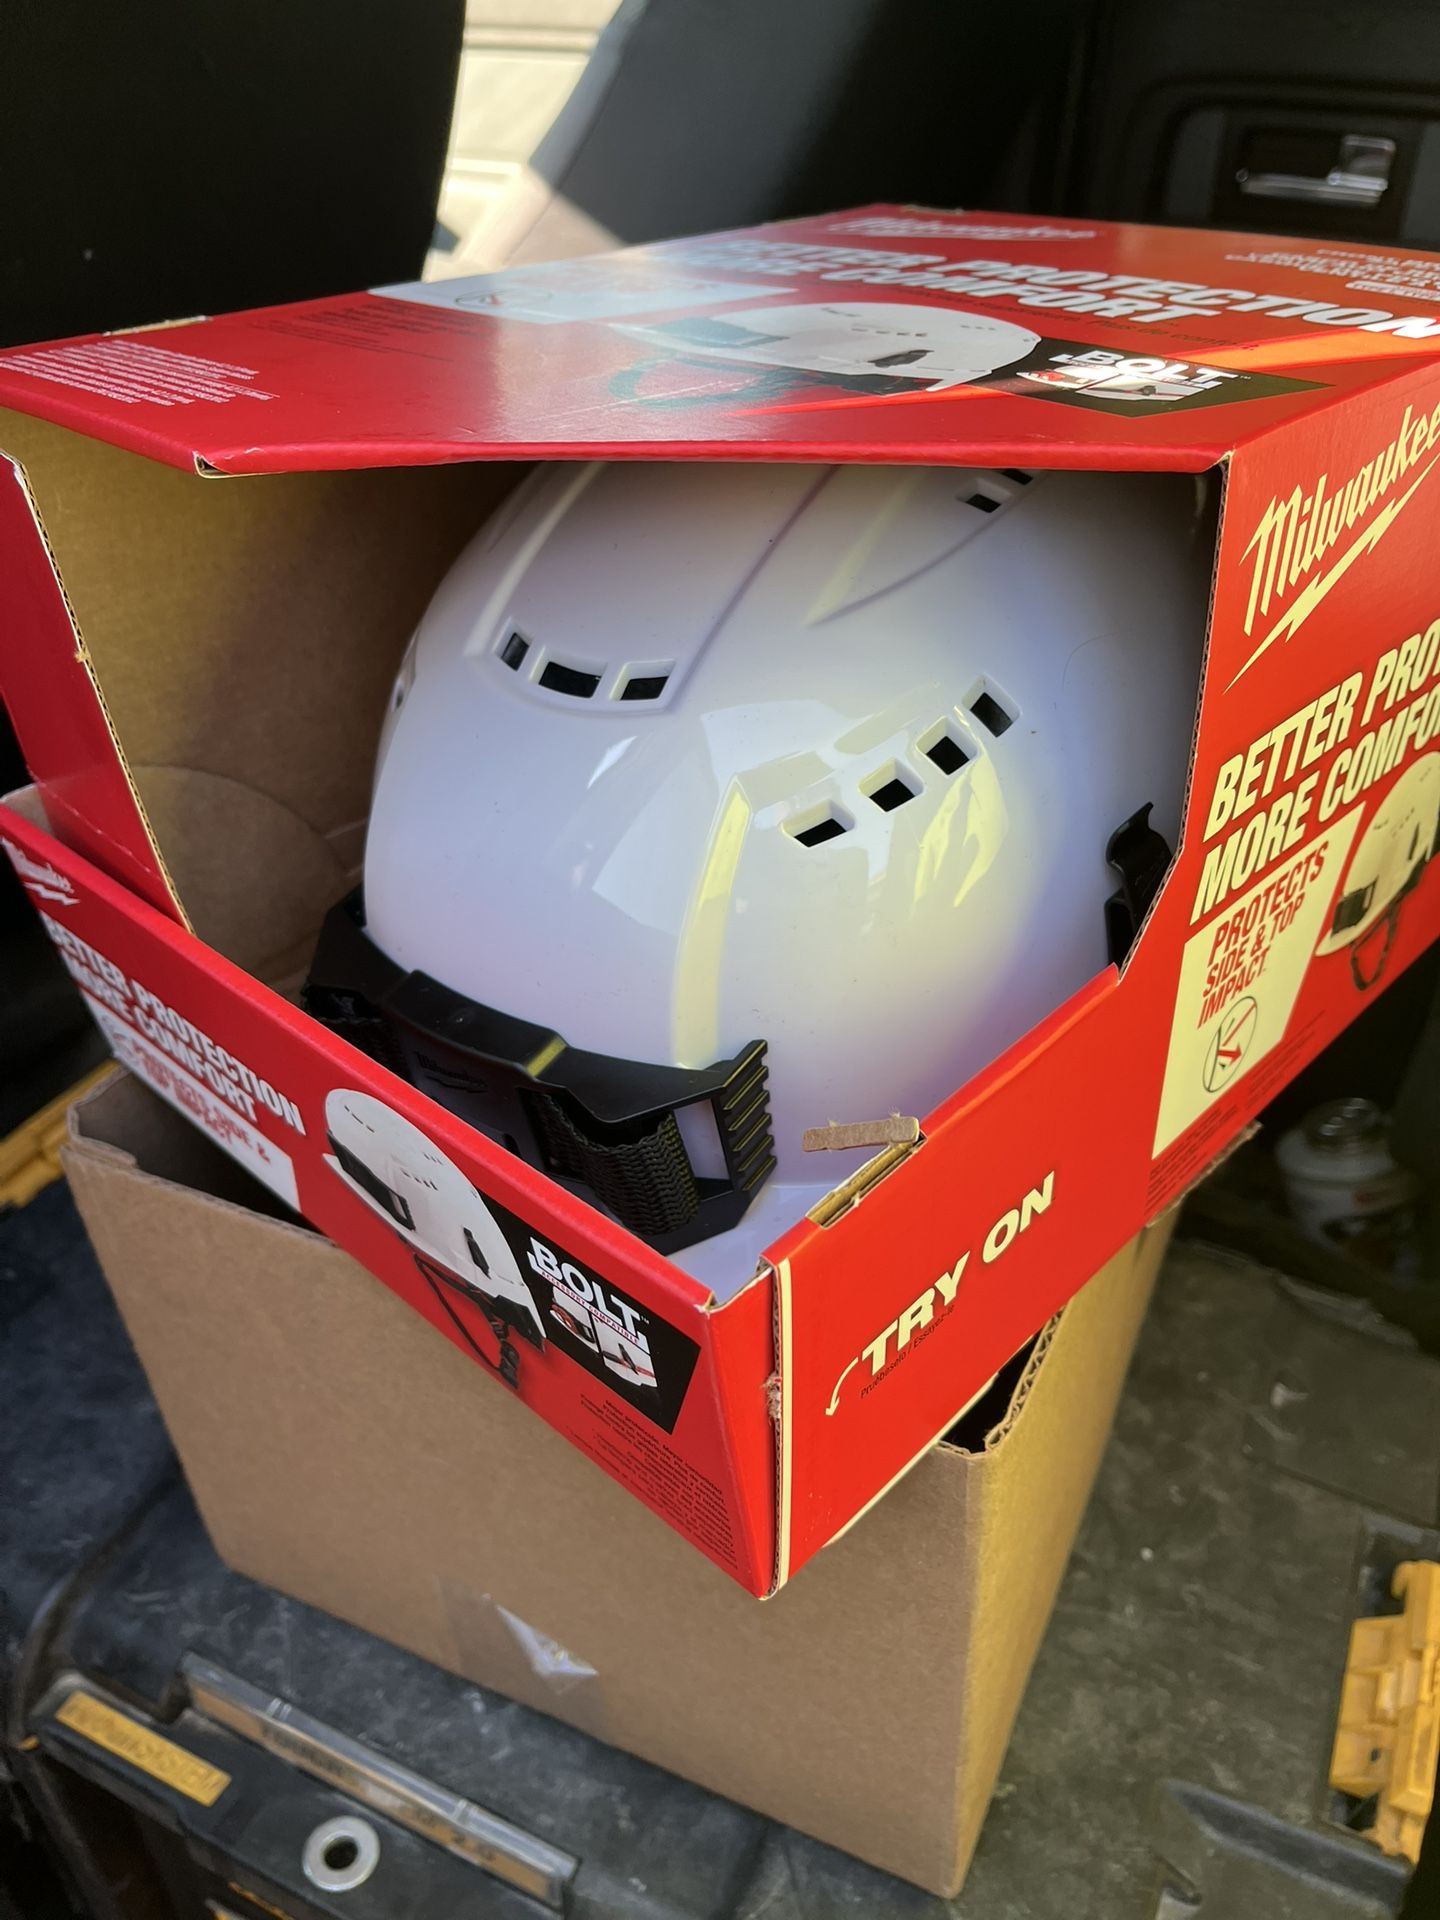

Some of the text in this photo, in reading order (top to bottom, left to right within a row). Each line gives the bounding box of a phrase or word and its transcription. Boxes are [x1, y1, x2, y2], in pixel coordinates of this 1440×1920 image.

[820, 267, 1222, 323] COMFORT
[926, 260, 1440, 339] PROTECTION
[1203, 672, 1363, 843] BETTER
[1190, 770, 1320, 925] MORE
[1207, 840, 1329, 968] PROTECTS
[1203, 892, 1305, 998] SIDE & TOP
[130, 978, 306, 1136] PROTECTION
[133, 1006, 257, 1123] COMFORT
[541, 1271, 639, 1344] ACCESSORY COMPATIBLE
[862, 1170, 1054, 1376] TRY ON
